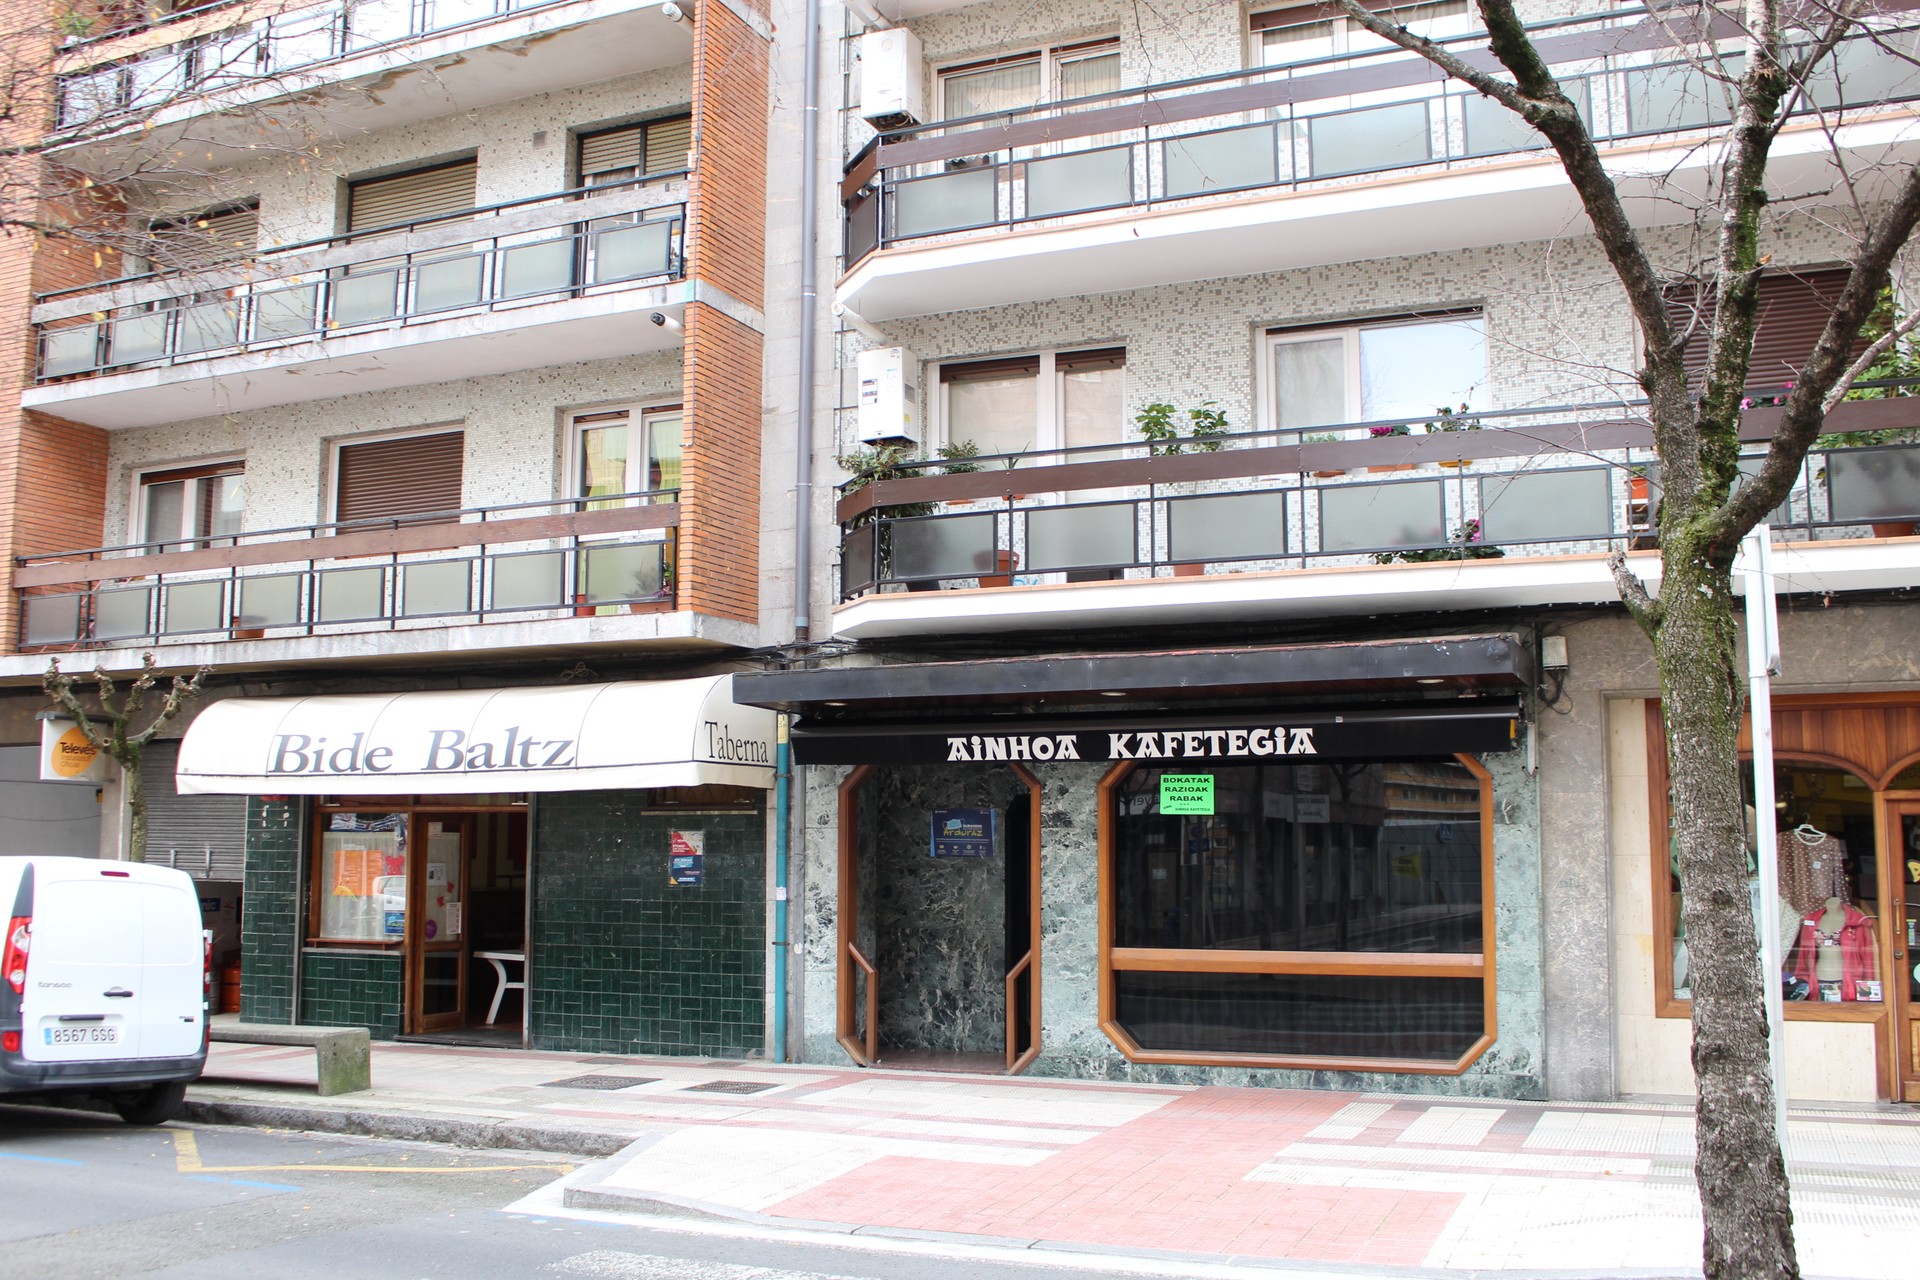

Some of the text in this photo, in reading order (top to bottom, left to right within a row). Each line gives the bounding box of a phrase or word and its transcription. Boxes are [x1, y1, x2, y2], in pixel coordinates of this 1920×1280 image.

[268, 726, 575, 774] Bide Baltz
[704, 721, 769, 763] Taberna
[54, 1028, 116, 1043] 8567 GSG
